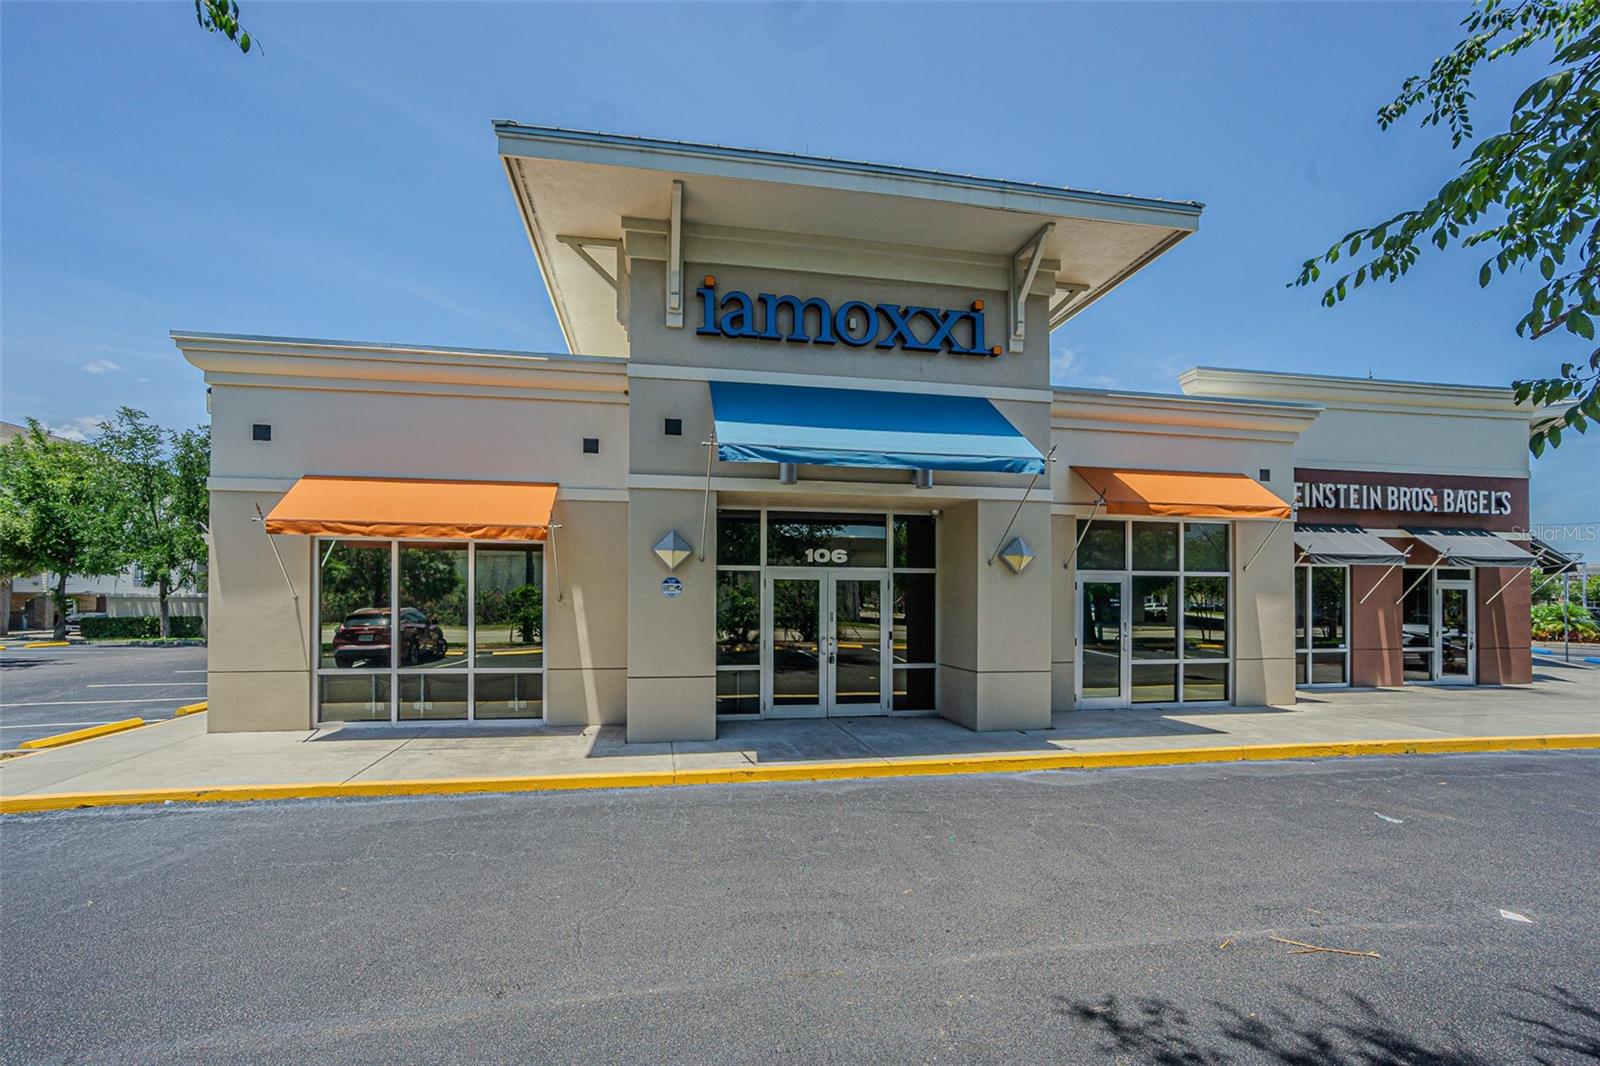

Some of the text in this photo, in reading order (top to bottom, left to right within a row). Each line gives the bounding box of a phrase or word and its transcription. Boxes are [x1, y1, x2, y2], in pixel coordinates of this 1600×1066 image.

[1293, 482, 1512, 516] EINSTEIN BROS. BAGELS
[805, 548, 848, 564] 106
